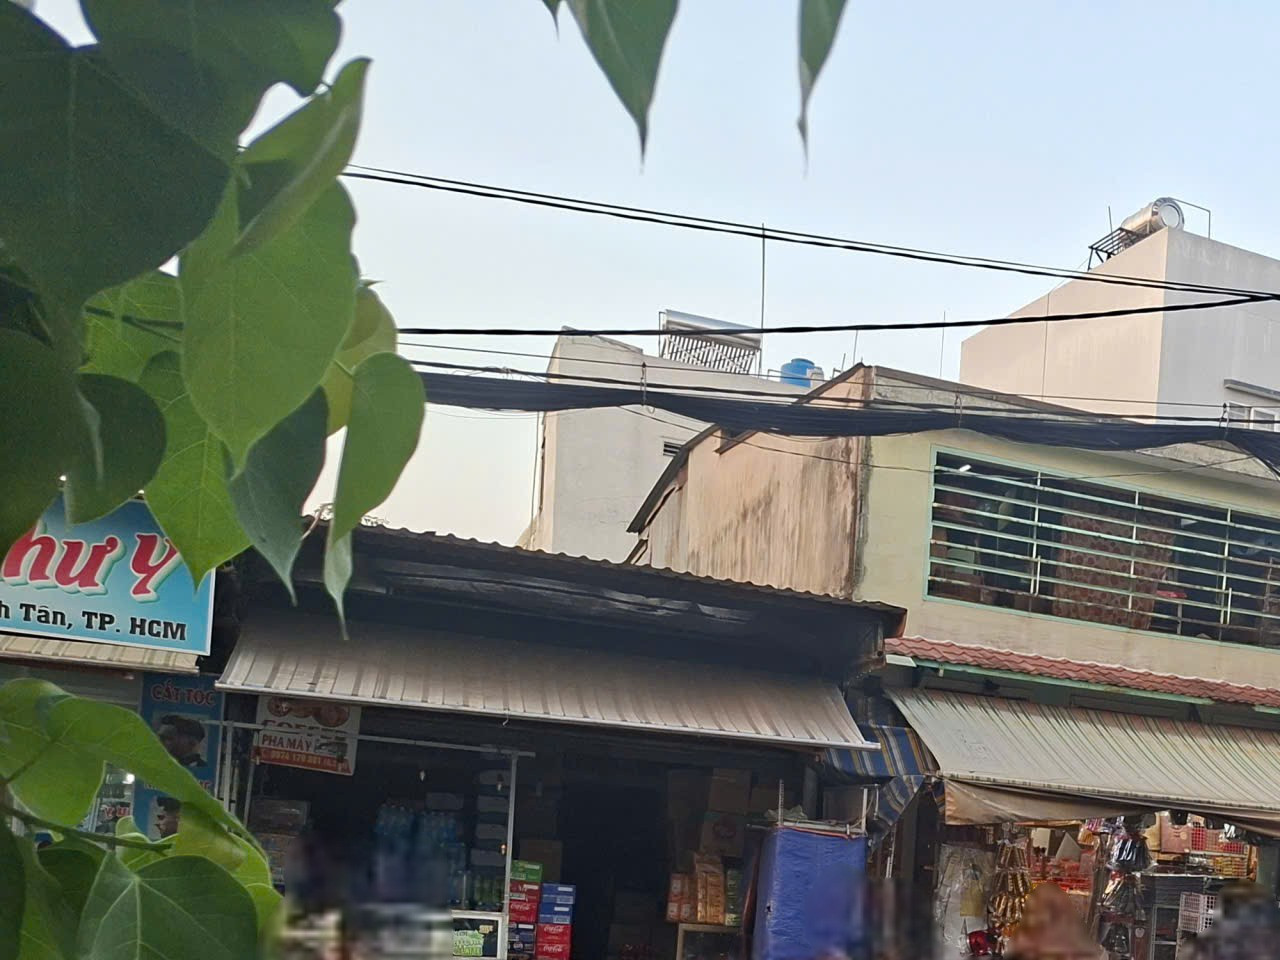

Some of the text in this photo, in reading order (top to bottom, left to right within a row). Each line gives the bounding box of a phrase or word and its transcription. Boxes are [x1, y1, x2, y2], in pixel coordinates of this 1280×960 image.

[19, 603, 73, 630] Tân,
[82, 611, 120, 633] TP.
[129, 617, 187, 641] HCM
